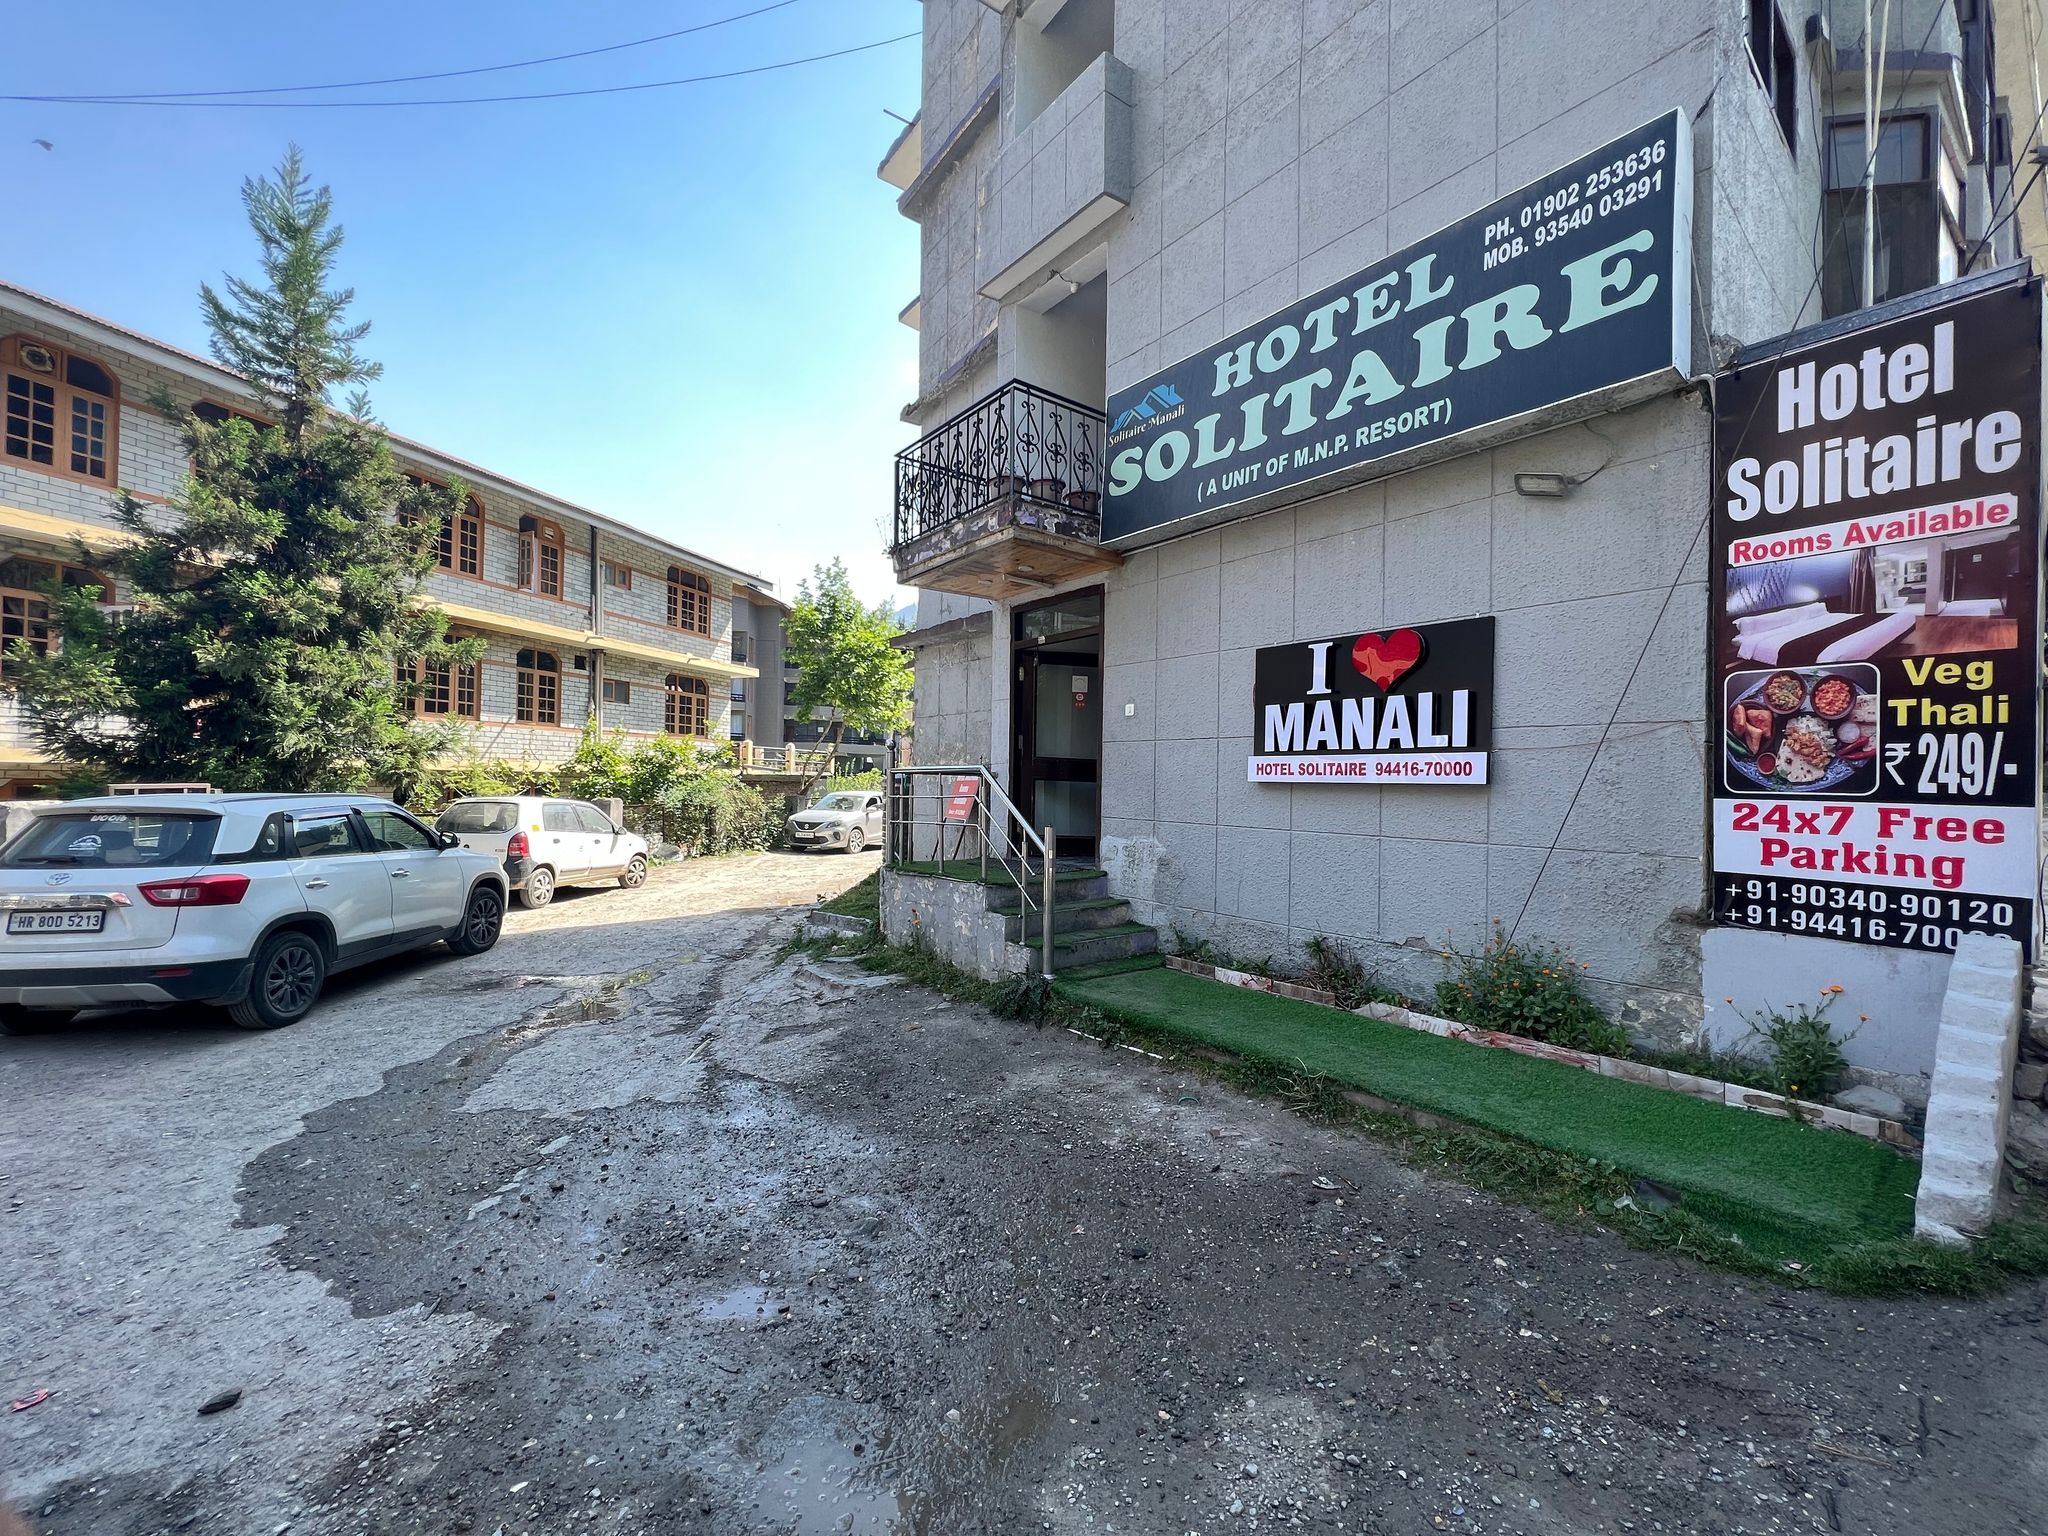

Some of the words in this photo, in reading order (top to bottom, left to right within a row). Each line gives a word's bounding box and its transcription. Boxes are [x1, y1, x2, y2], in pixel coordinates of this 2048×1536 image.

[1483, 236, 1529, 272] MOB.
[1534, 203, 1594, 247] 93540
[1599, 169, 1663, 217] 03291
[1484, 216, 1515, 246] PH.
[1521, 182, 1580, 228] 01902
[1585, 139, 1667, 198] 253636
[1211, 252, 1455, 398] HOTEL
[1108, 229, 1660, 497] SOLITAIRE
[1776, 319, 1955, 434] Hotel
[1108, 422, 1147, 448] Solitaire
[1147, 404, 1185, 430] Manali
[1220, 463, 1262, 493] UNIT
[1265, 454, 1289, 478] OF
[1293, 434, 1349, 468] M.N.P.
[1355, 397, 1453, 449] RESORT)
[1726, 410, 2023, 522] Solitaire
[1733, 531, 1832, 564] Rooms
[1844, 499, 2011, 546] Available
[1306, 641, 1334, 696] I
[1903, 657, 1995, 691] Veg
[1264, 689, 1470, 752] MANALI
[1888, 694, 2010, 727] Thali
[1256, 762, 1295, 776] HOTEL
[1298, 762, 1367, 776] SOLITAIRE
[1375, 761, 1473, 777] 94416-70000
[1732, 802, 1855, 836] 24x7
[1877, 807, 2006, 845] Free
[1760, 837, 1966, 889] Parking
[17, 916, 35, 929] HR
[38, 915, 63, 928] 80D
[67, 914, 100, 927] 5213
